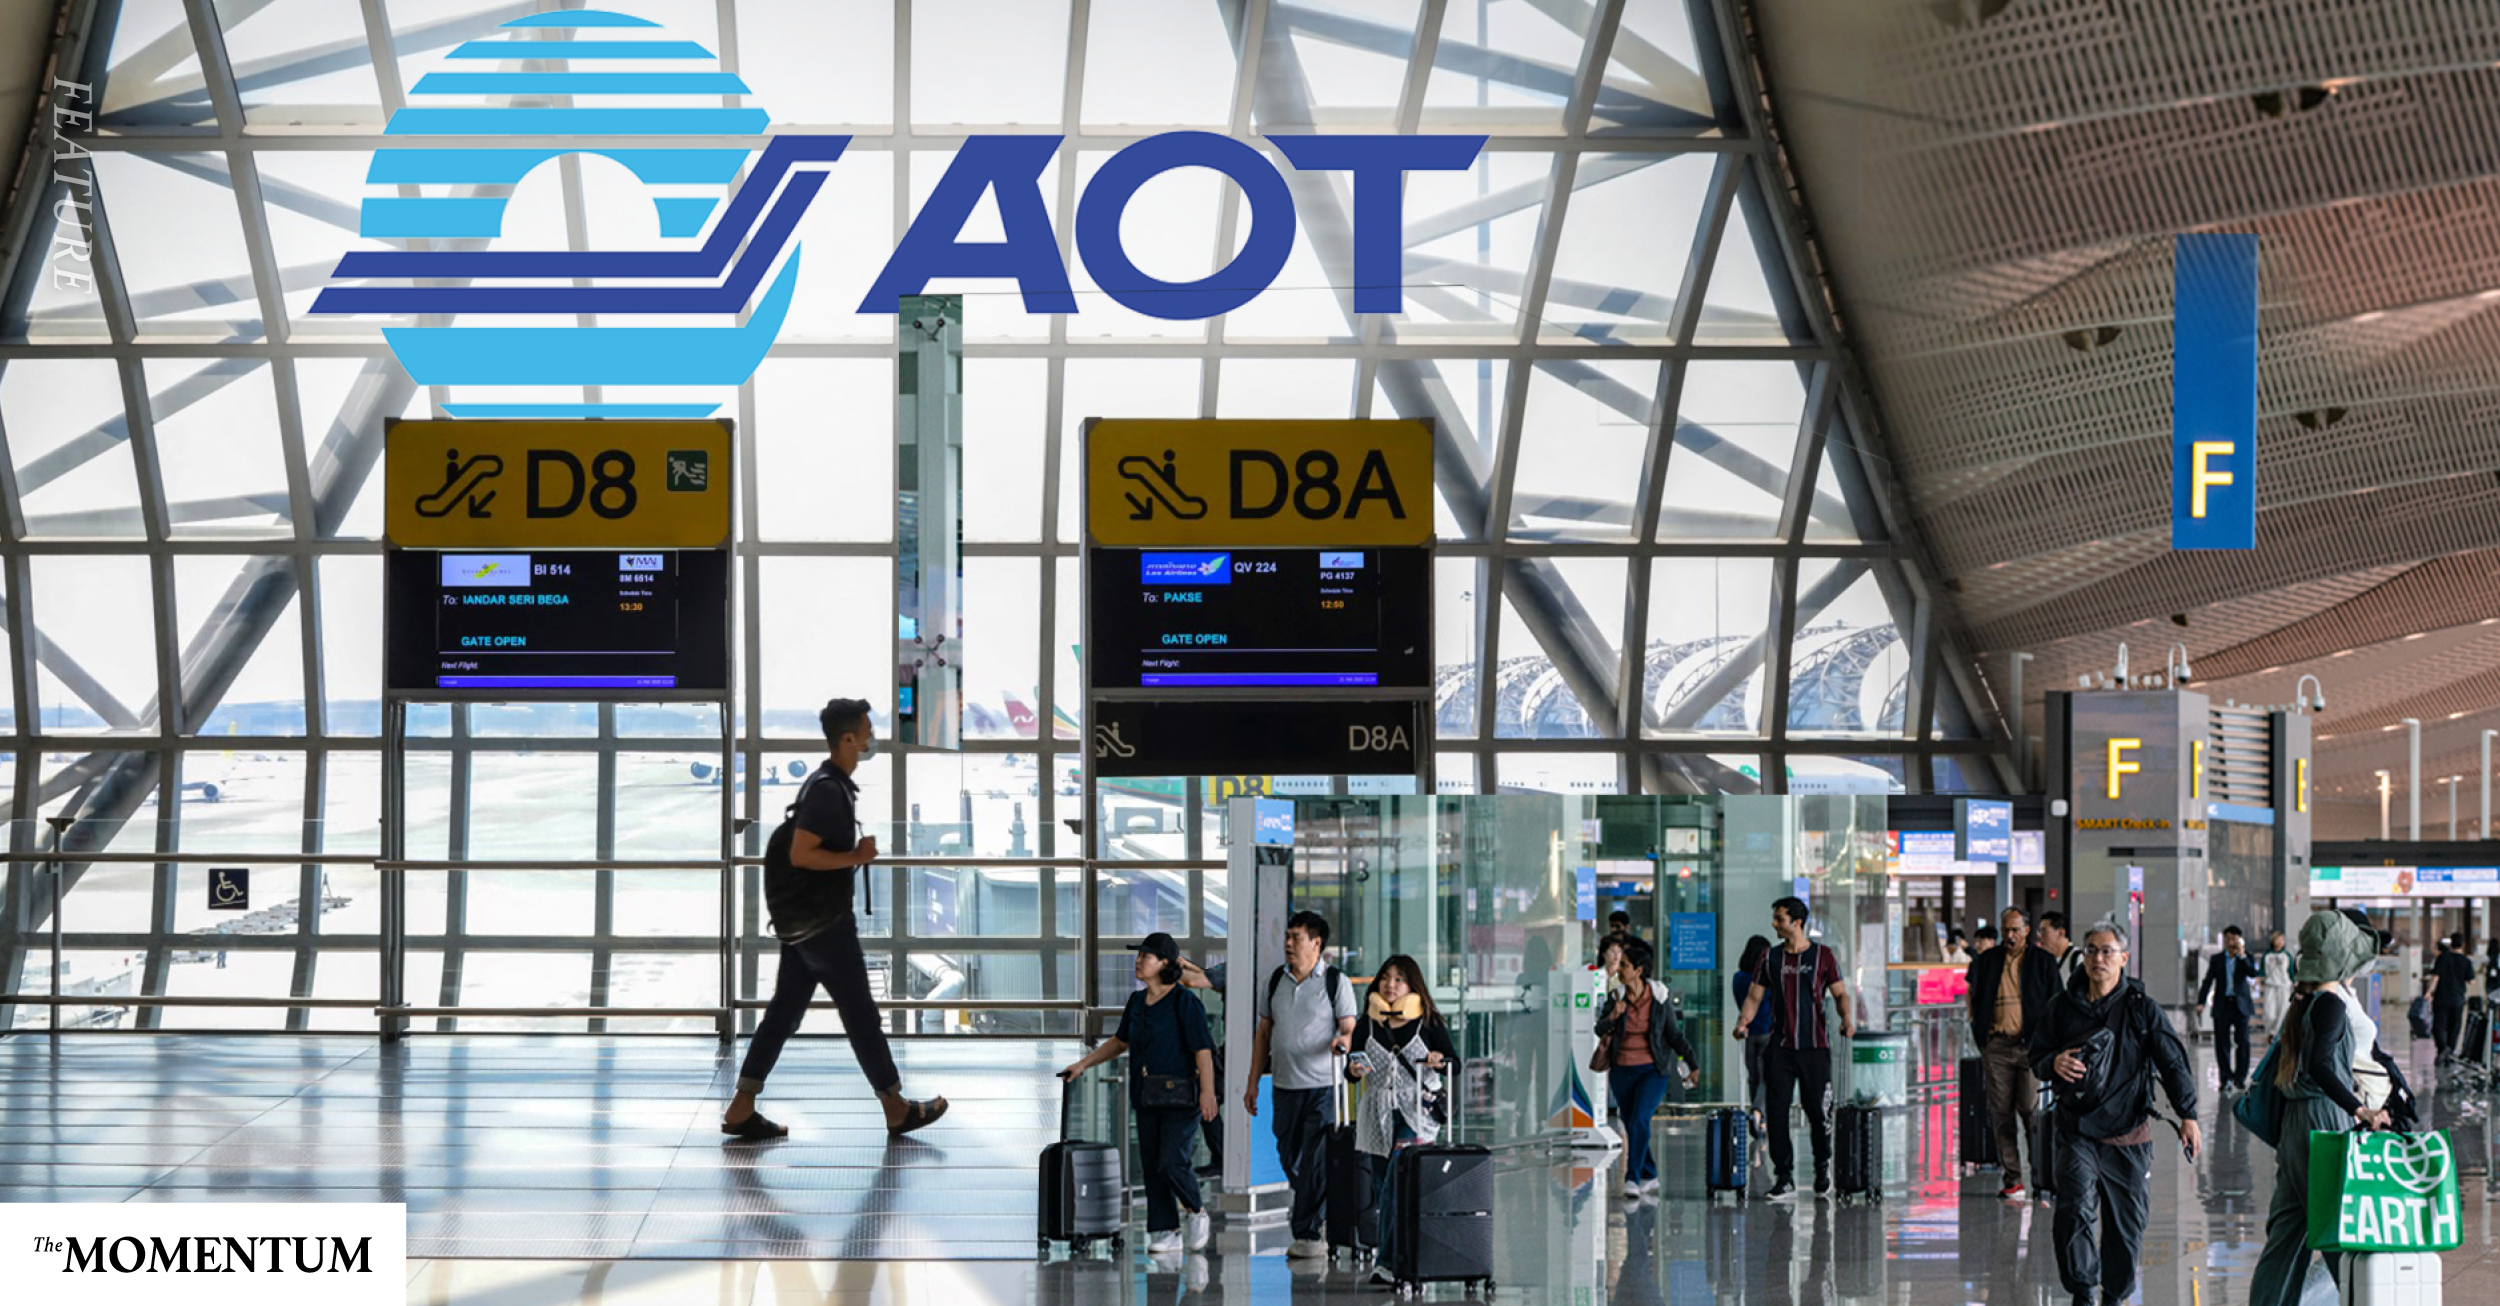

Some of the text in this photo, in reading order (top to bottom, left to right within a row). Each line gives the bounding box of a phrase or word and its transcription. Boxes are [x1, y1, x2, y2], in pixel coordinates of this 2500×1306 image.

[525, 449, 638, 519] D8
[1229, 449, 1406, 520] D8A
[2191, 441, 2235, 518] F
[534, 564, 571, 575] BI 514
[1234, 562, 1277, 574] QV 224
[1335, 572, 1355, 580] 4137
[443, 595, 458, 605] To:
[509, 595, 535, 605] SERI
[537, 595, 569, 605] BEGA
[1143, 592, 1203, 603] To: PAKSE
[461, 636, 526, 646] GATE OPEN
[1162, 634, 1227, 645] GATE OPEN
[441, 661, 457, 669] Next
[1348, 726, 1409, 751] D8A
[2107, 737, 2142, 800] F
[2076, 819, 2119, 829] SMART
[2339, 1193, 2459, 1245] EARTH
